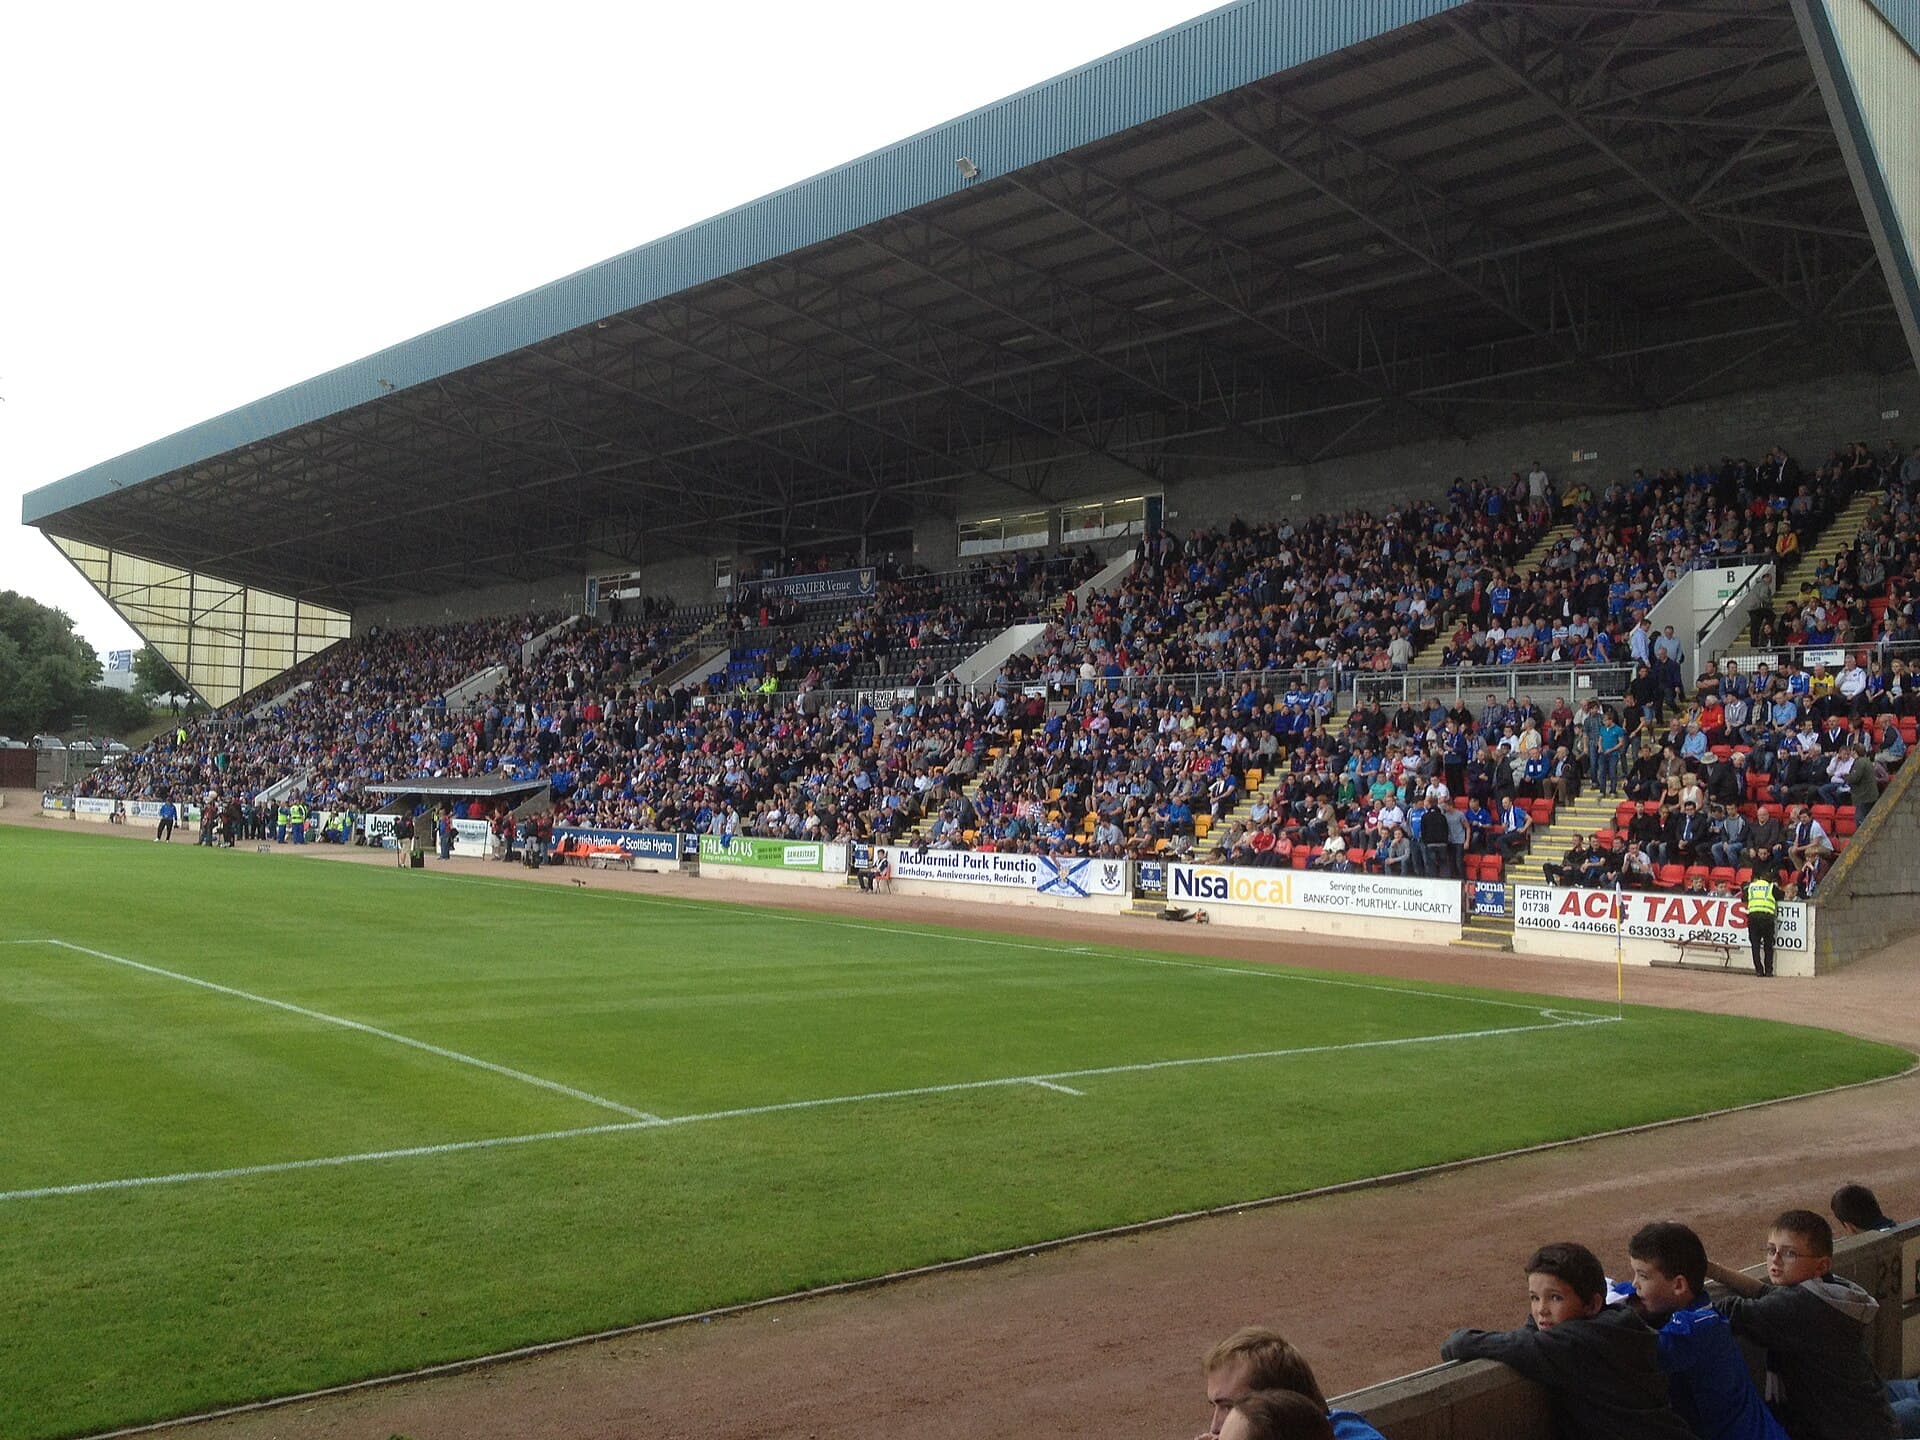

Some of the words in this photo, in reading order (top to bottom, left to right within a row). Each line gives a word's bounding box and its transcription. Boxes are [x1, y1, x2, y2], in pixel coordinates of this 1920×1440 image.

[1727, 570, 1735, 583] B
[784, 581, 825, 596] PREMIER
[826, 580, 850, 592] Venue
[626, 837, 651, 851] Scottish
[652, 839, 673, 855] Hydro
[702, 839, 724, 855] TALK
[741, 841, 753, 857] US
[900, 851, 959, 868] McDiarmid
[963, 855, 989, 870] Park
[993, 856, 1037, 872] Functio
[898, 867, 935, 878] Birthdays,
[936, 870, 992, 882] Anniversaries,
[1329, 880, 1357, 895] Serving
[1357, 882, 1370, 893] the
[1371, 884, 1423, 897] Communities
[1520, 889, 1552, 900] PERTH
[1303, 893, 1349, 906] BANKFOOT
[1356, 898, 1398, 910] MURTHLY
[1403, 902, 1453, 914] LUNCARTY
[1522, 902, 1550, 913] 01738
[1559, 891, 1632, 921] ACE
[1643, 895, 1750, 929] TAXIS
[1776, 906, 1800, 918] RTH
[1518, 917, 1561, 929] 444000
[1572, 921, 1617, 933] 444666
[1628, 925, 1675, 939] 633033
[1776, 920, 1797, 931] 738
